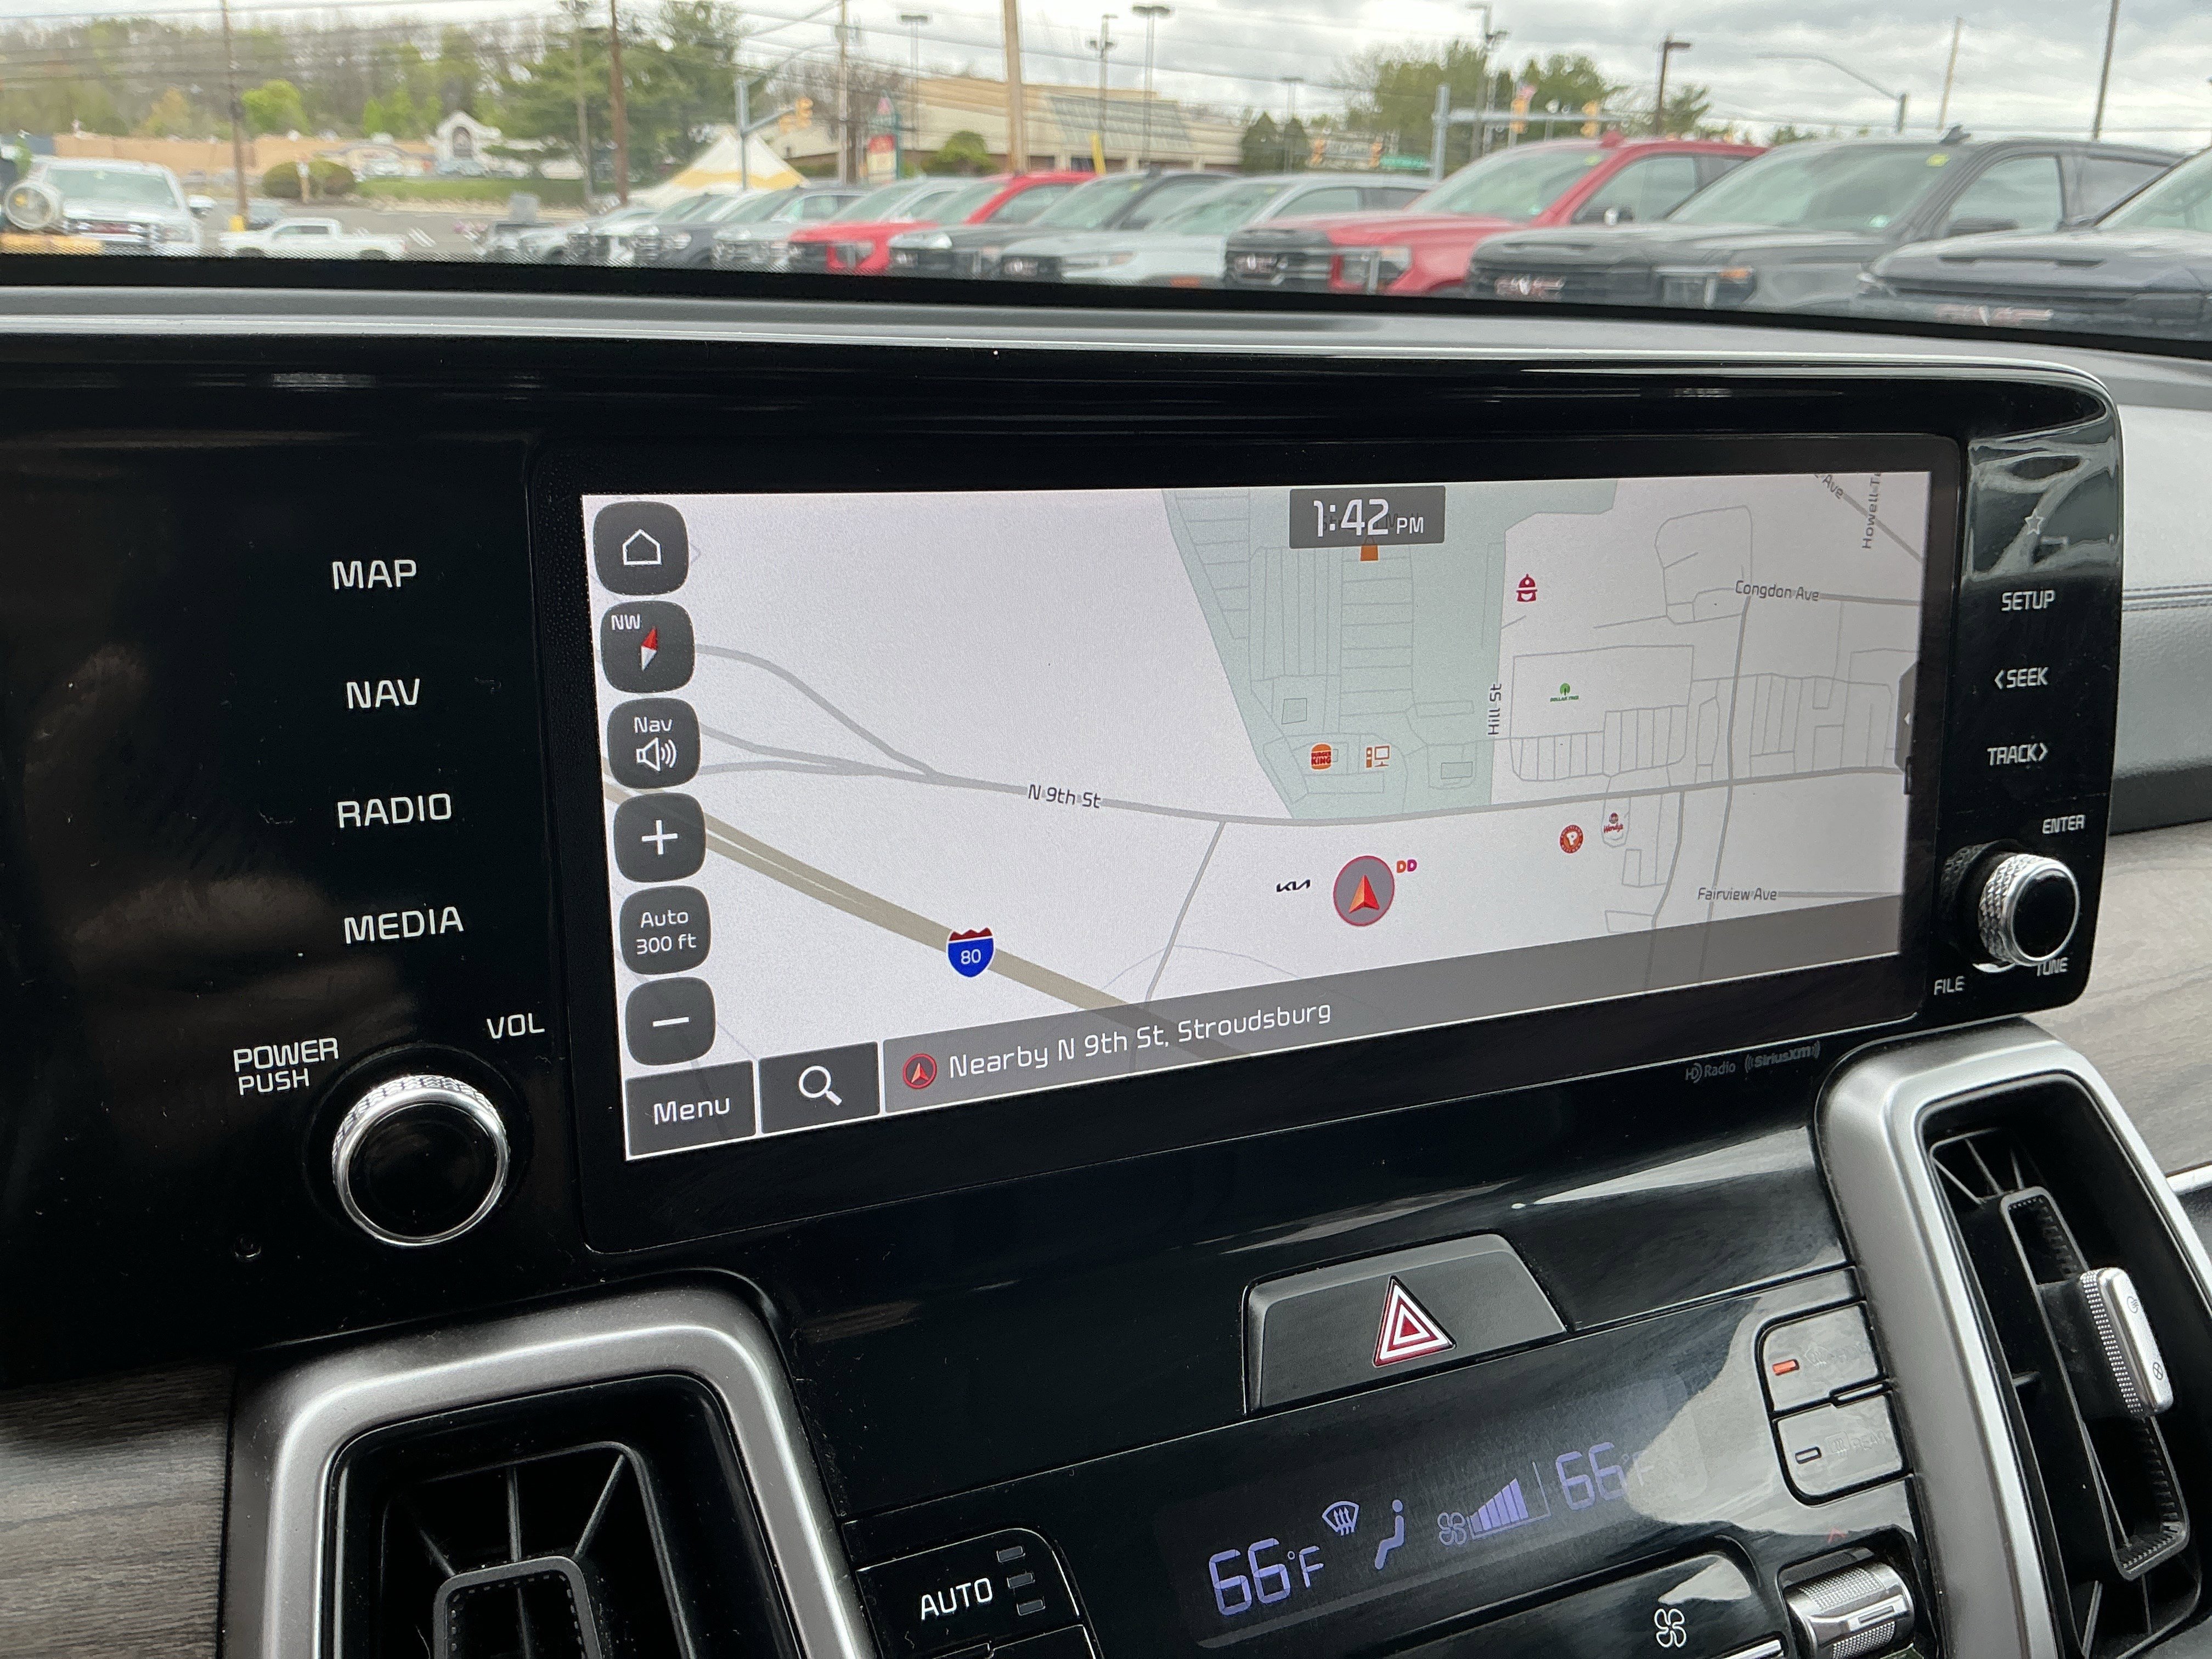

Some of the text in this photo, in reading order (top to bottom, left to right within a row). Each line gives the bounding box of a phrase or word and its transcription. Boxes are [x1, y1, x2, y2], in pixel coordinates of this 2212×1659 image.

[1822, 474, 1843, 499] Ave
[1313, 498, 1389, 538] 1:42
[1396, 516, 1424, 534] PM
[1861, 493, 1878, 549] Howell
[332, 560, 416, 589] MAP
[1735, 580, 1819, 601] Congdon Ave
[2002, 590, 2055, 611] SETUP
[611, 614, 640, 630] NW
[347, 679, 420, 709] NAV
[1488, 684, 1502, 735] Hill St
[634, 717, 672, 733] Nav
[1312, 757, 1331, 765] KING
[1028, 785, 1101, 809] N 9th St
[337, 793, 452, 828] RADIO
[2042, 814, 2085, 834] ENTER
[1698, 887, 1777, 900] Fairview Ave
[345, 907, 464, 944] MEDIA
[641, 910, 688, 928] Auto
[636, 933, 696, 955] 300 ft
[961, 949, 981, 964] 80
[2036, 957, 2069, 977] TUNE
[1934, 976, 1965, 995] FILE
[487, 1013, 545, 1039] VOL
[950, 1005, 1331, 1078] Nearby N 9th St, Stroudsburg
[234, 1038, 338, 1072] POWER
[1704, 1061, 1736, 1077] Radio
[235, 1068, 309, 1095] PUSH
[654, 1098, 730, 1125] Menu
[922, 1578, 992, 1620] AUTO
